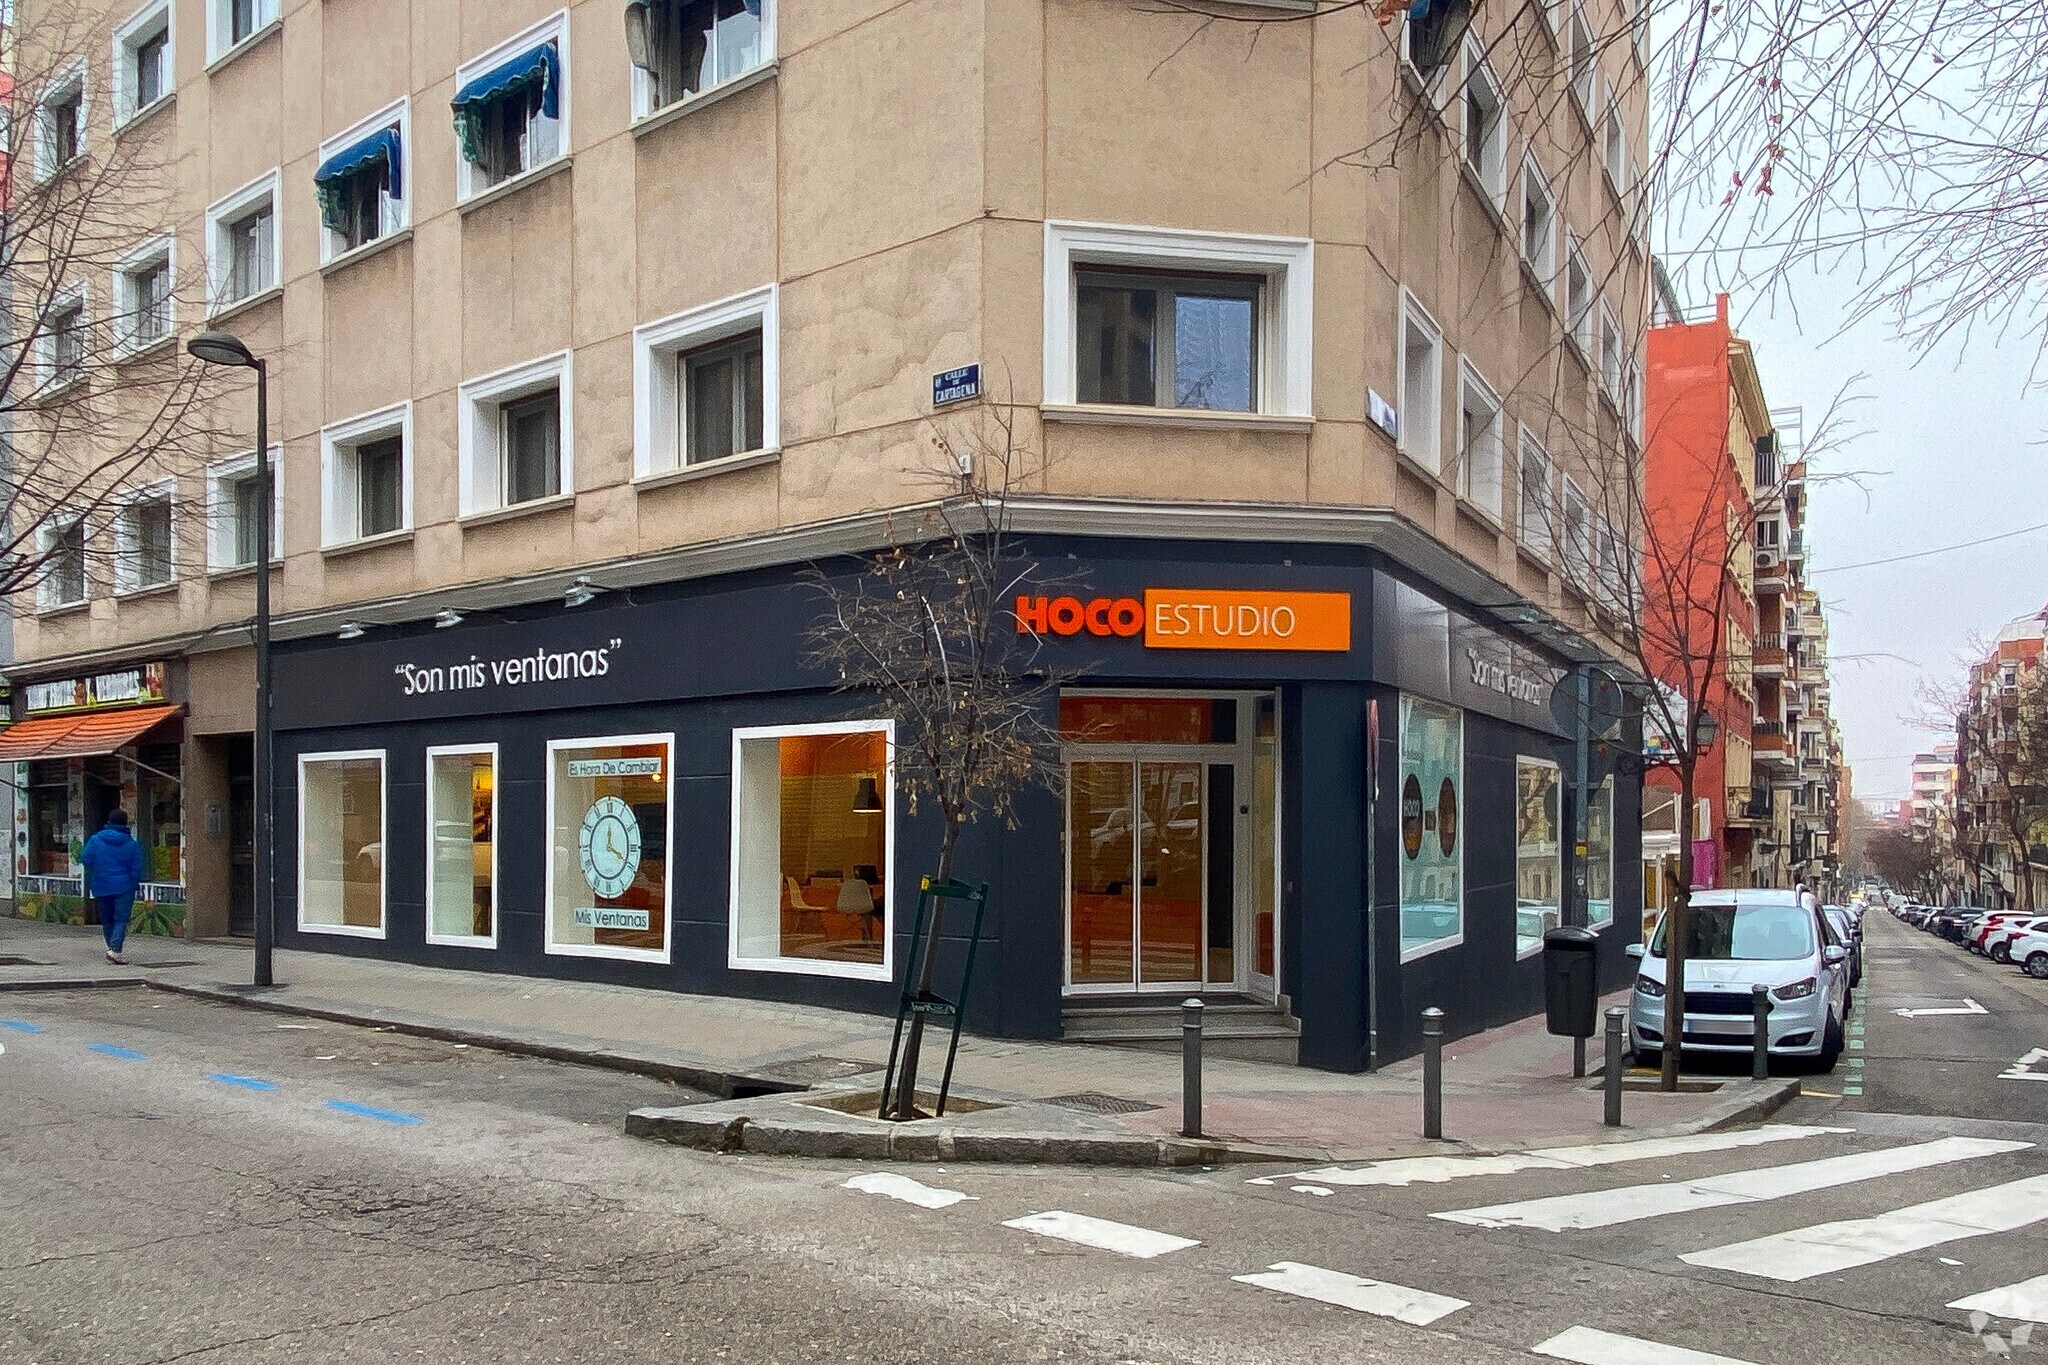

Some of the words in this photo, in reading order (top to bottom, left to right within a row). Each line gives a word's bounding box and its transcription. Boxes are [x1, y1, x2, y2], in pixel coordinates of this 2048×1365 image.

[945, 368, 968, 381] CALLE
[936, 383, 976, 403] CARTAGENA
[1015, 595, 1145, 637] HOCO
[1155, 603, 1295, 637] ESTUDIO
[450, 655, 485, 690] mis
[580, 763, 600, 775] Hora
[603, 762, 615, 774] De
[618, 760, 658, 773] Cambiar
[575, 910, 591, 924] Mis
[594, 910, 647, 928] Ventanas
